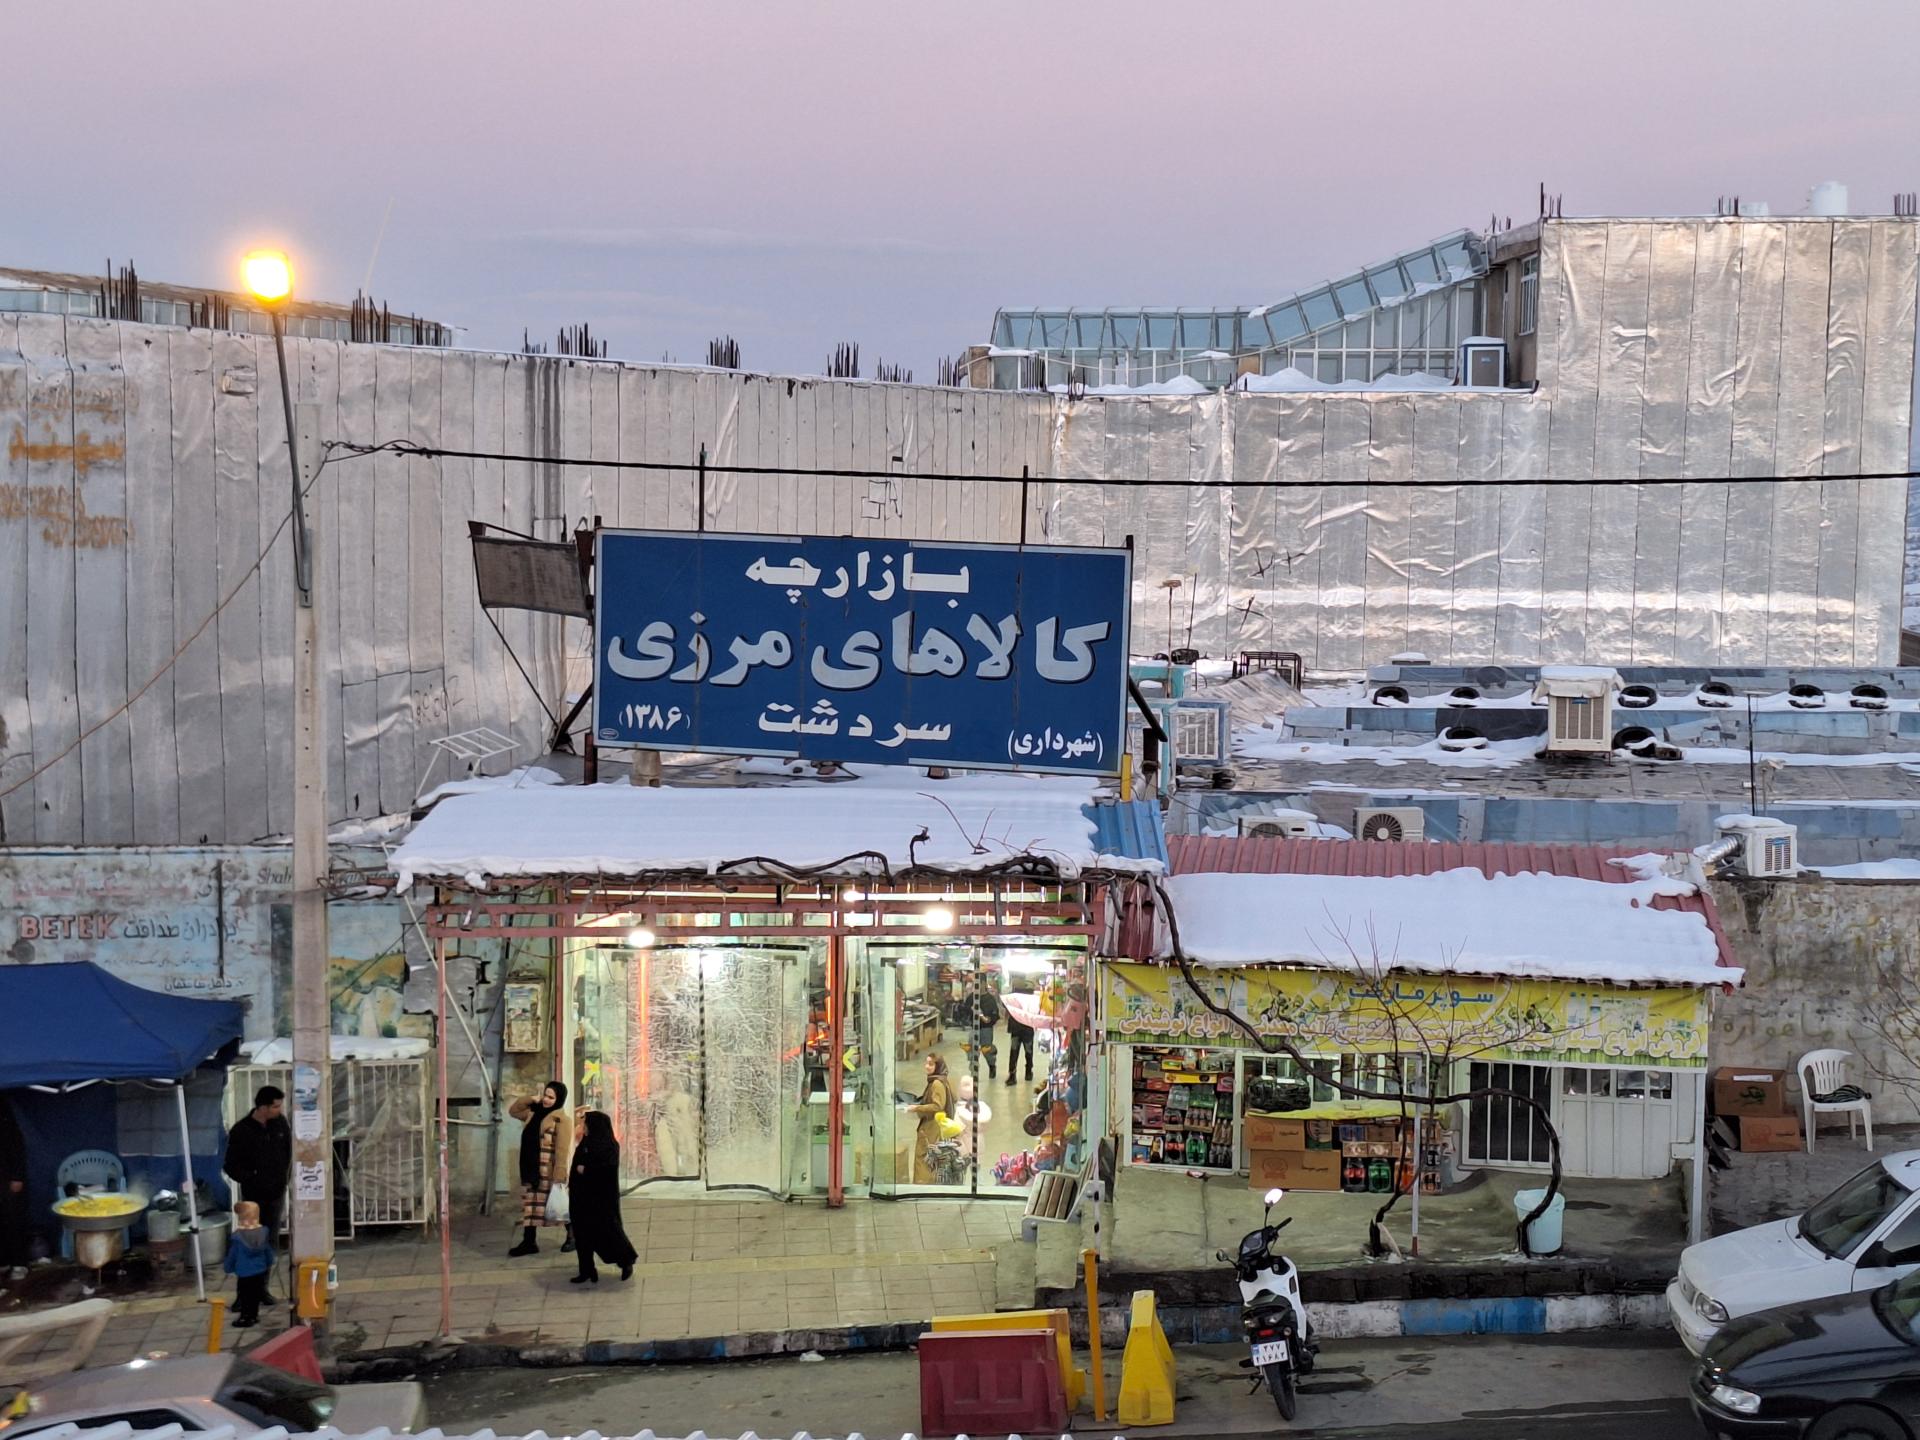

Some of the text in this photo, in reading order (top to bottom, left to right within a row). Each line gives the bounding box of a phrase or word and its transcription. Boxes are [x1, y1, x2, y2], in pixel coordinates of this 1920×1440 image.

[744, 551, 970, 609] بازارچه
[607, 610, 1110, 690] کالاهای مرزی
[758, 699, 952, 748] سردشت
[1007, 727, 1104, 764] (شهرداری)
[20, 913, 119, 940] BETEK
[183, 917, 237, 942] بردران
[1118, 1009, 1187, 1037] نوشیدنی
